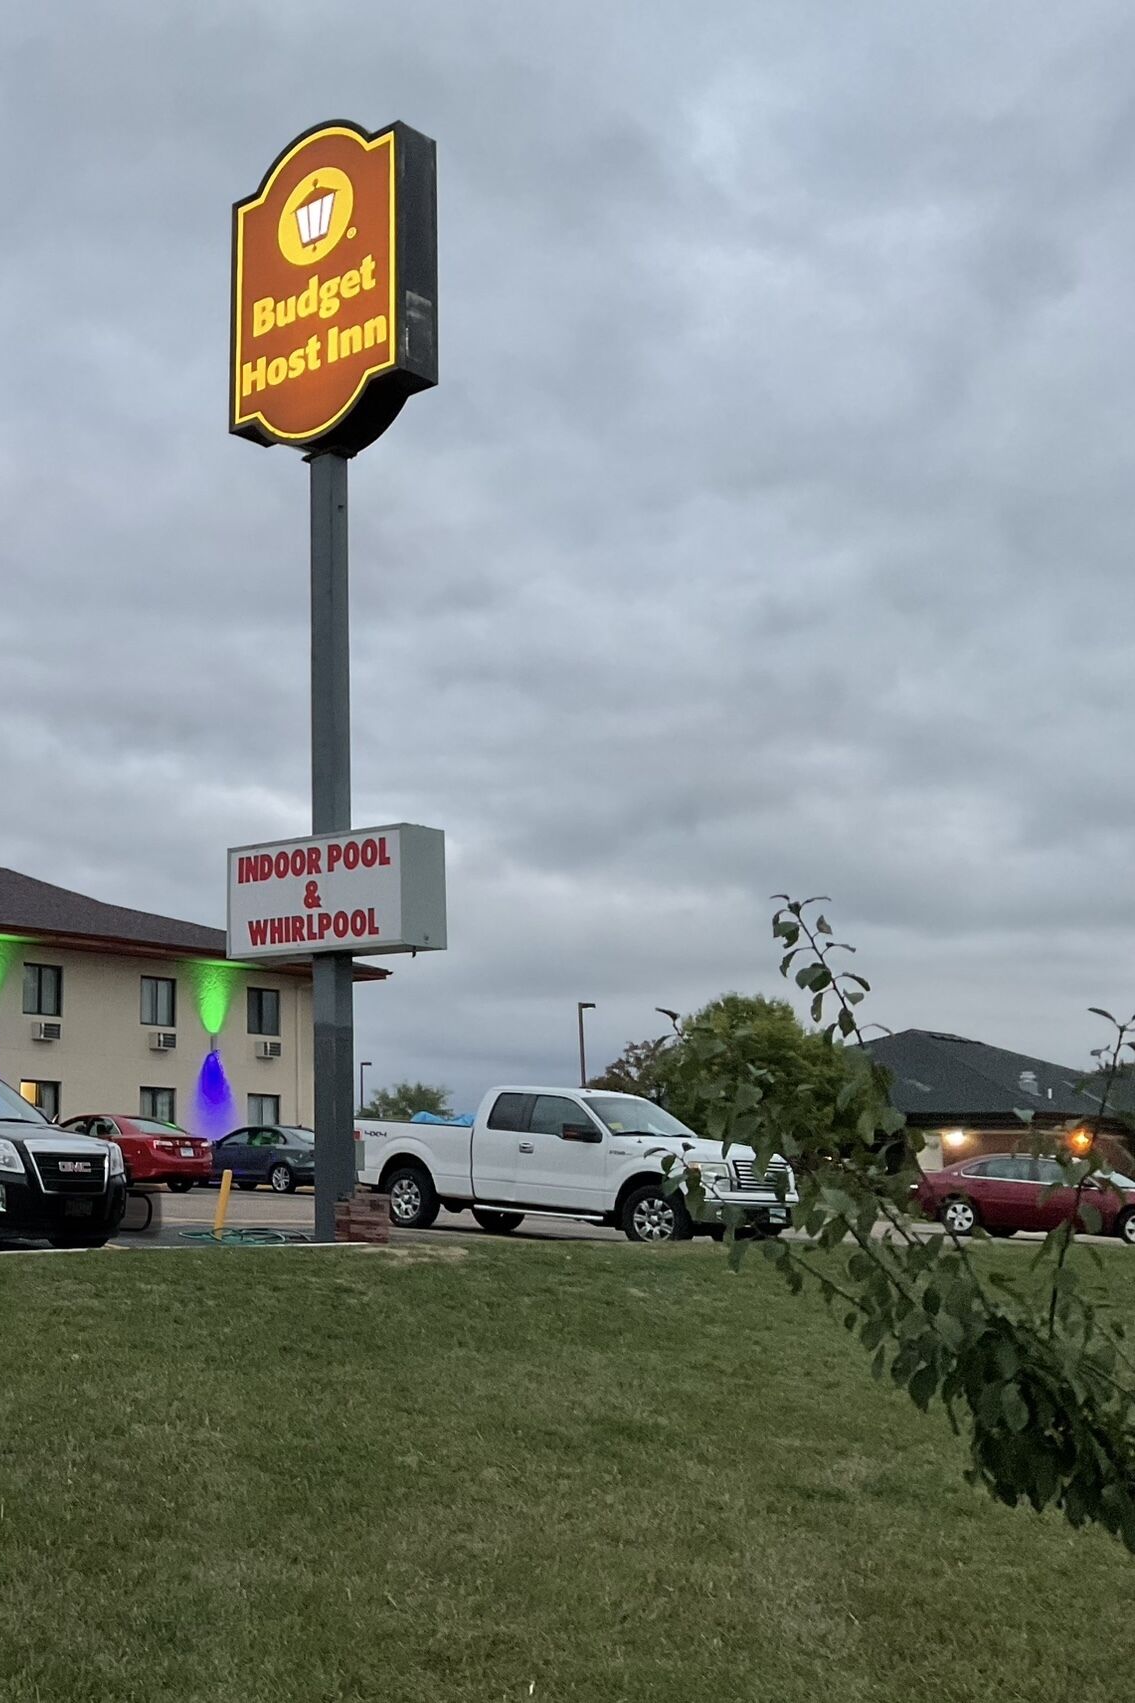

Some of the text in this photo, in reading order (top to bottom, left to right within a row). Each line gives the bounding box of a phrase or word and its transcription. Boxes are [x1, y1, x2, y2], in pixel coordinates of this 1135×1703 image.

[252, 254, 377, 338] Budget
[241, 314, 388, 397] Host Inn
[238, 837, 391, 884] INDOOR POOL
[303, 880, 322, 909] &
[248, 907, 380, 946] WHIRLPOOL
[58, 1161, 92, 1173] GMC
